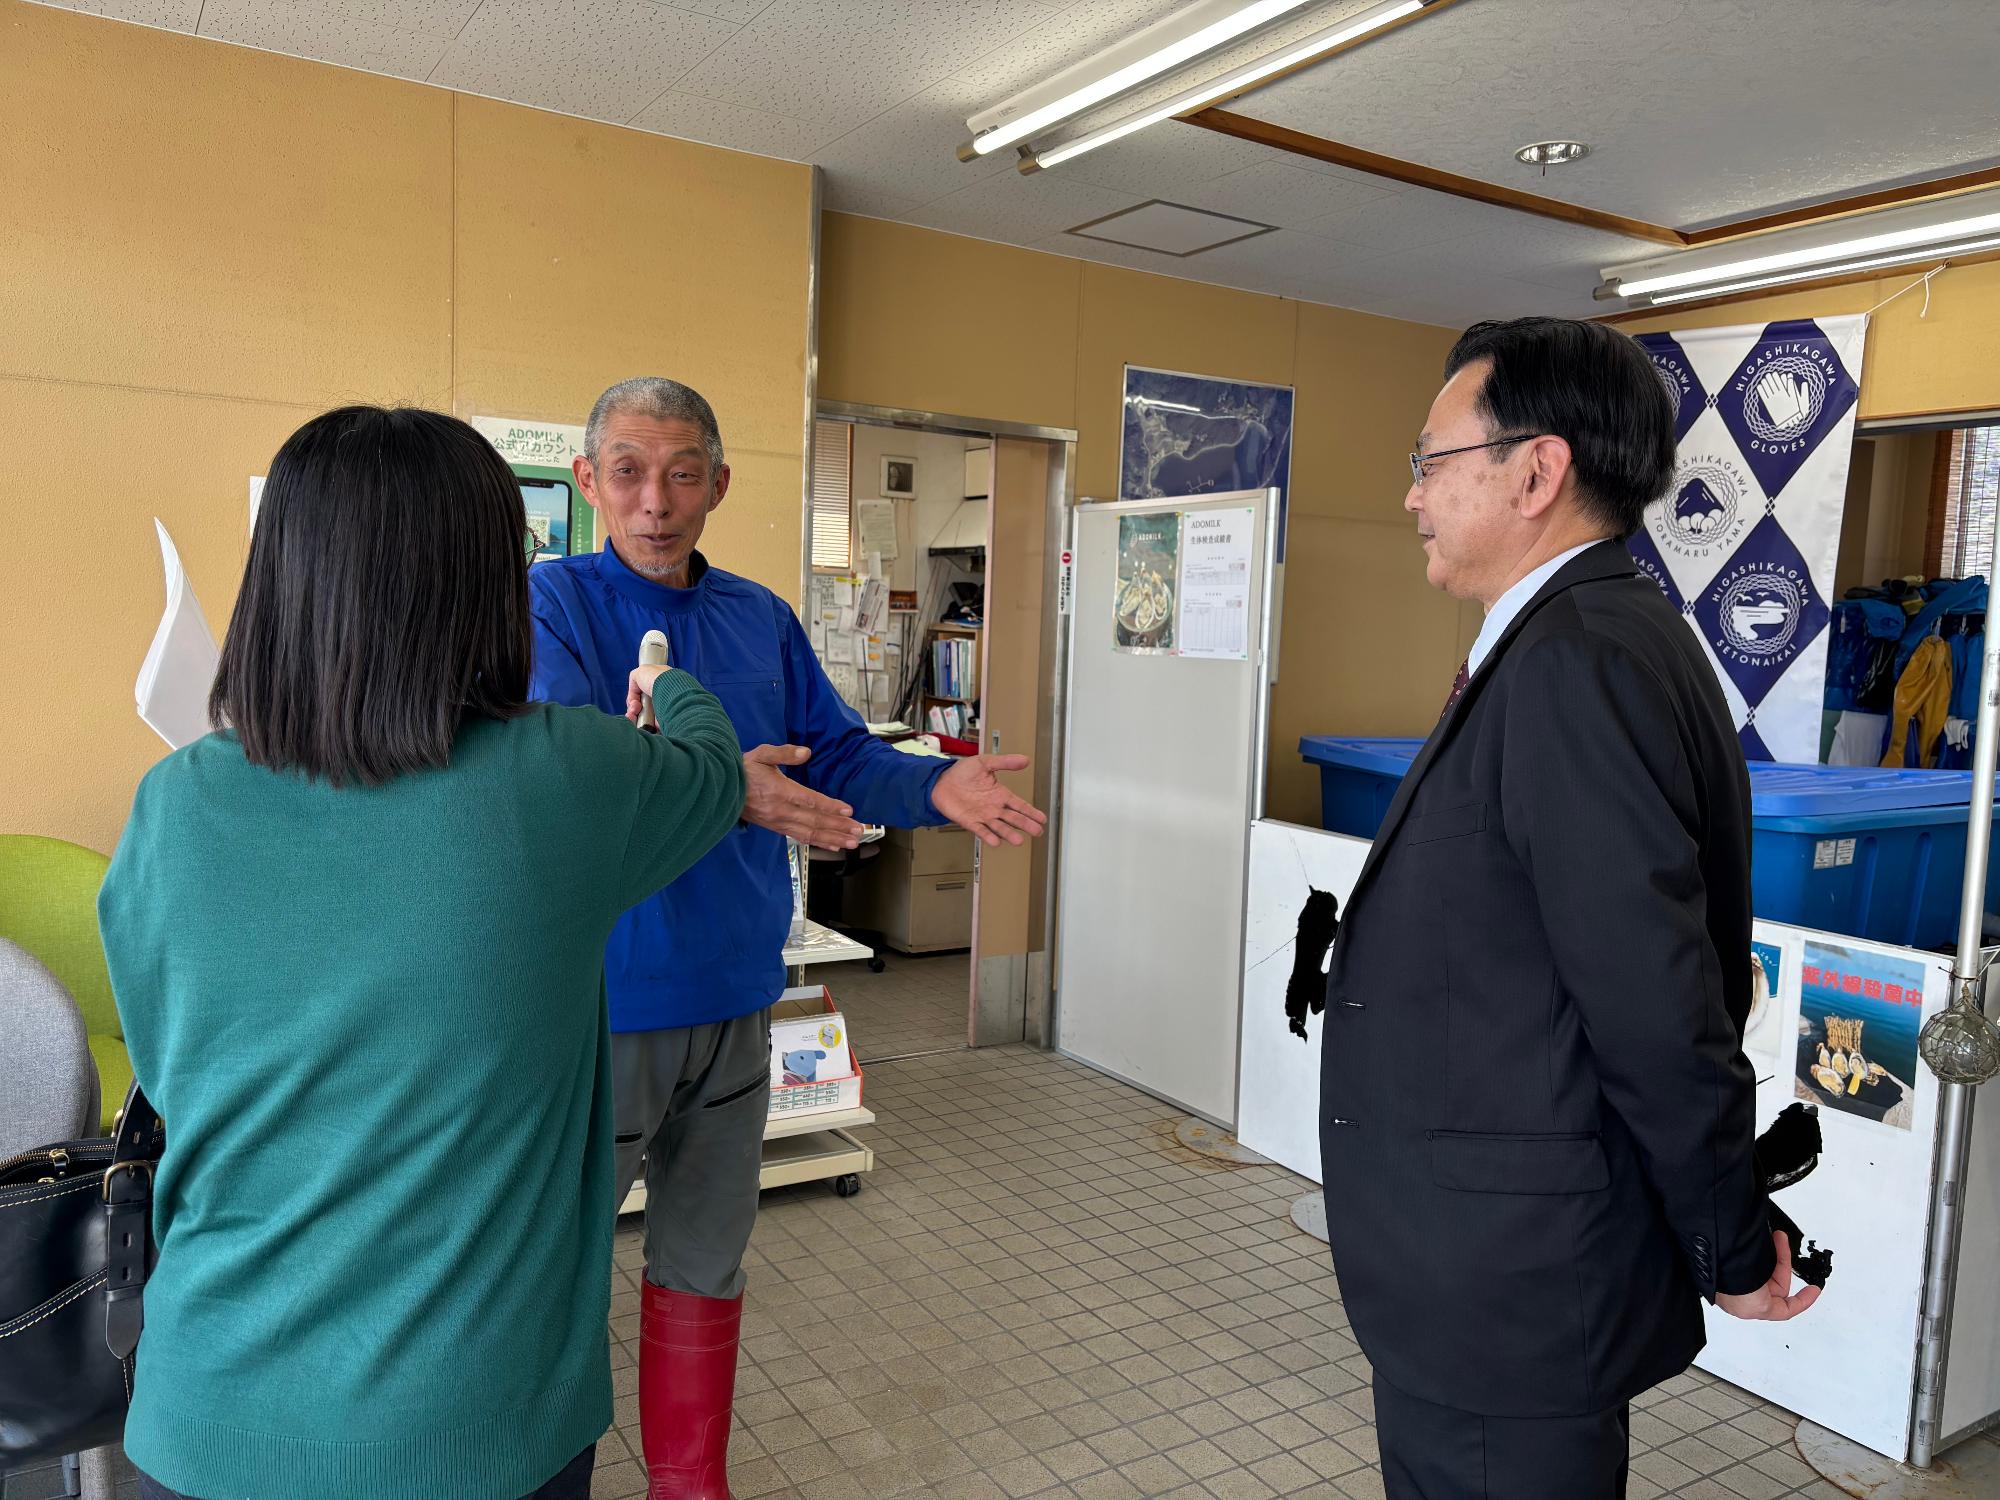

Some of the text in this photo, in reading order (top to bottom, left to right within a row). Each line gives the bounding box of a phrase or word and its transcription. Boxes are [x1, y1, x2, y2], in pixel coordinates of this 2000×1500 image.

[1736, 343, 1836, 392] HIGASHIKAGAWA
[508, 427, 564, 443] ADOMILK
[1750, 438, 1806, 454] GLOVES
[1191, 519, 1221, 529] ADOMILK
[1654, 516, 1745, 558] TORAMARU YAMA
[1712, 562, 1809, 607] HIGASHIKAGAWA
[1716, 639, 1797, 667] SETONAIKAI
